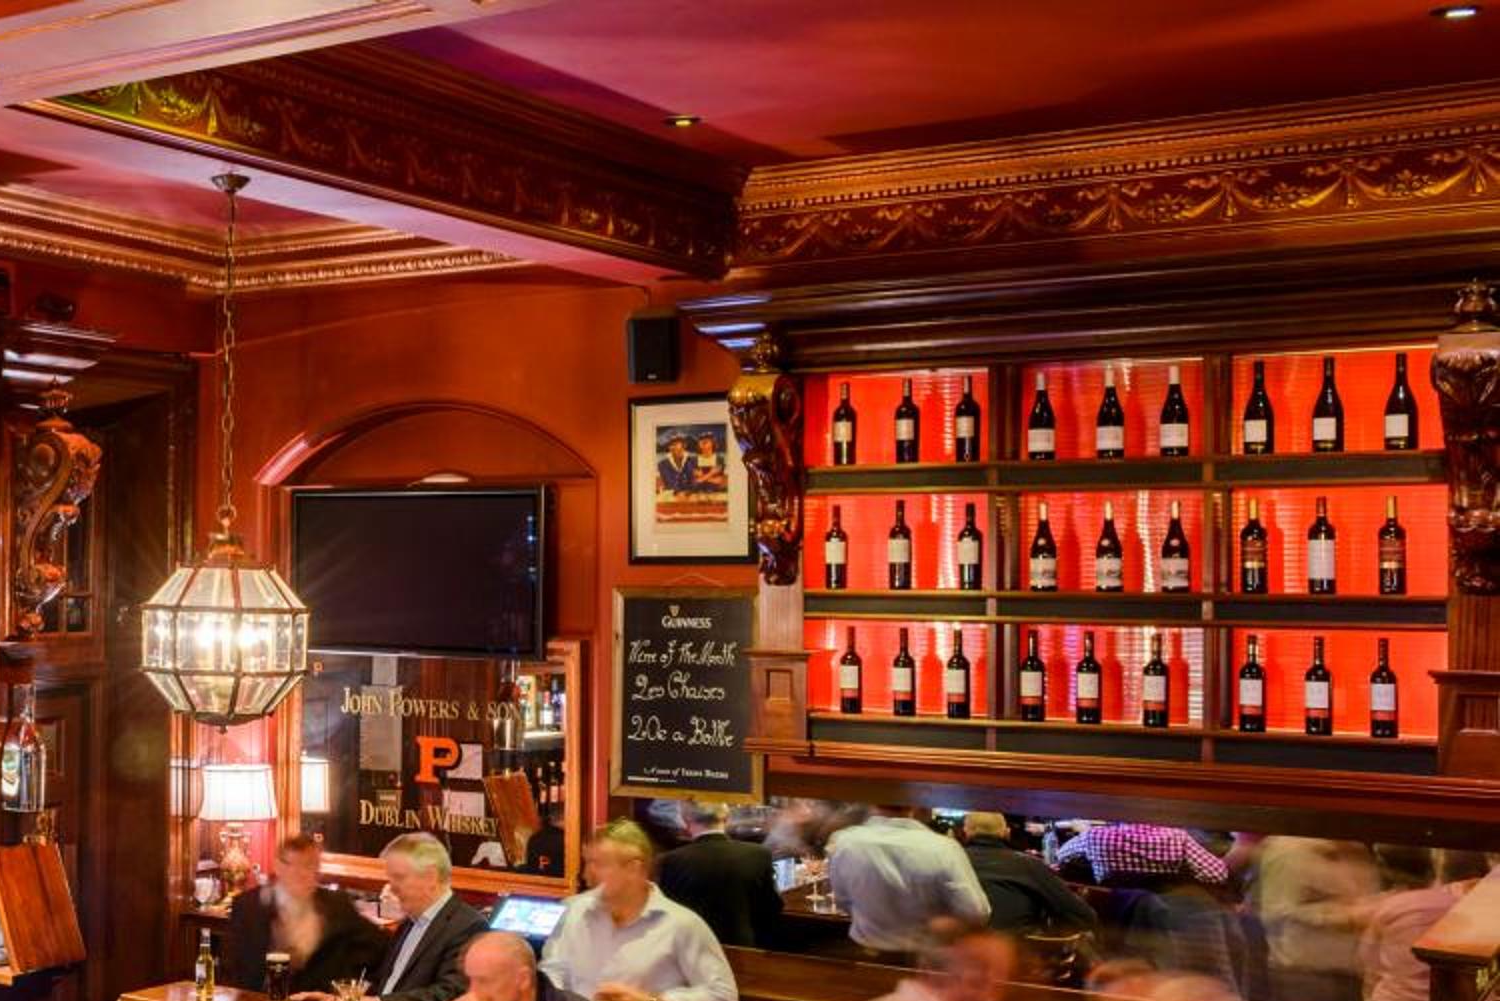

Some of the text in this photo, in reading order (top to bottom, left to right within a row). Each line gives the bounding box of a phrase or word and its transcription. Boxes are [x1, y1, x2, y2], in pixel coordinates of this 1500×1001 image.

[661, 615, 713, 629] GUINNESS
[659, 640, 677, 668] of
[341, 686, 383, 714] JOHN
[389, 690, 460, 720] POWERS
[467, 702, 480, 720] &
[414, 735, 460, 784] P
[359, 799, 499, 837] DUBLIN WHISKEY
